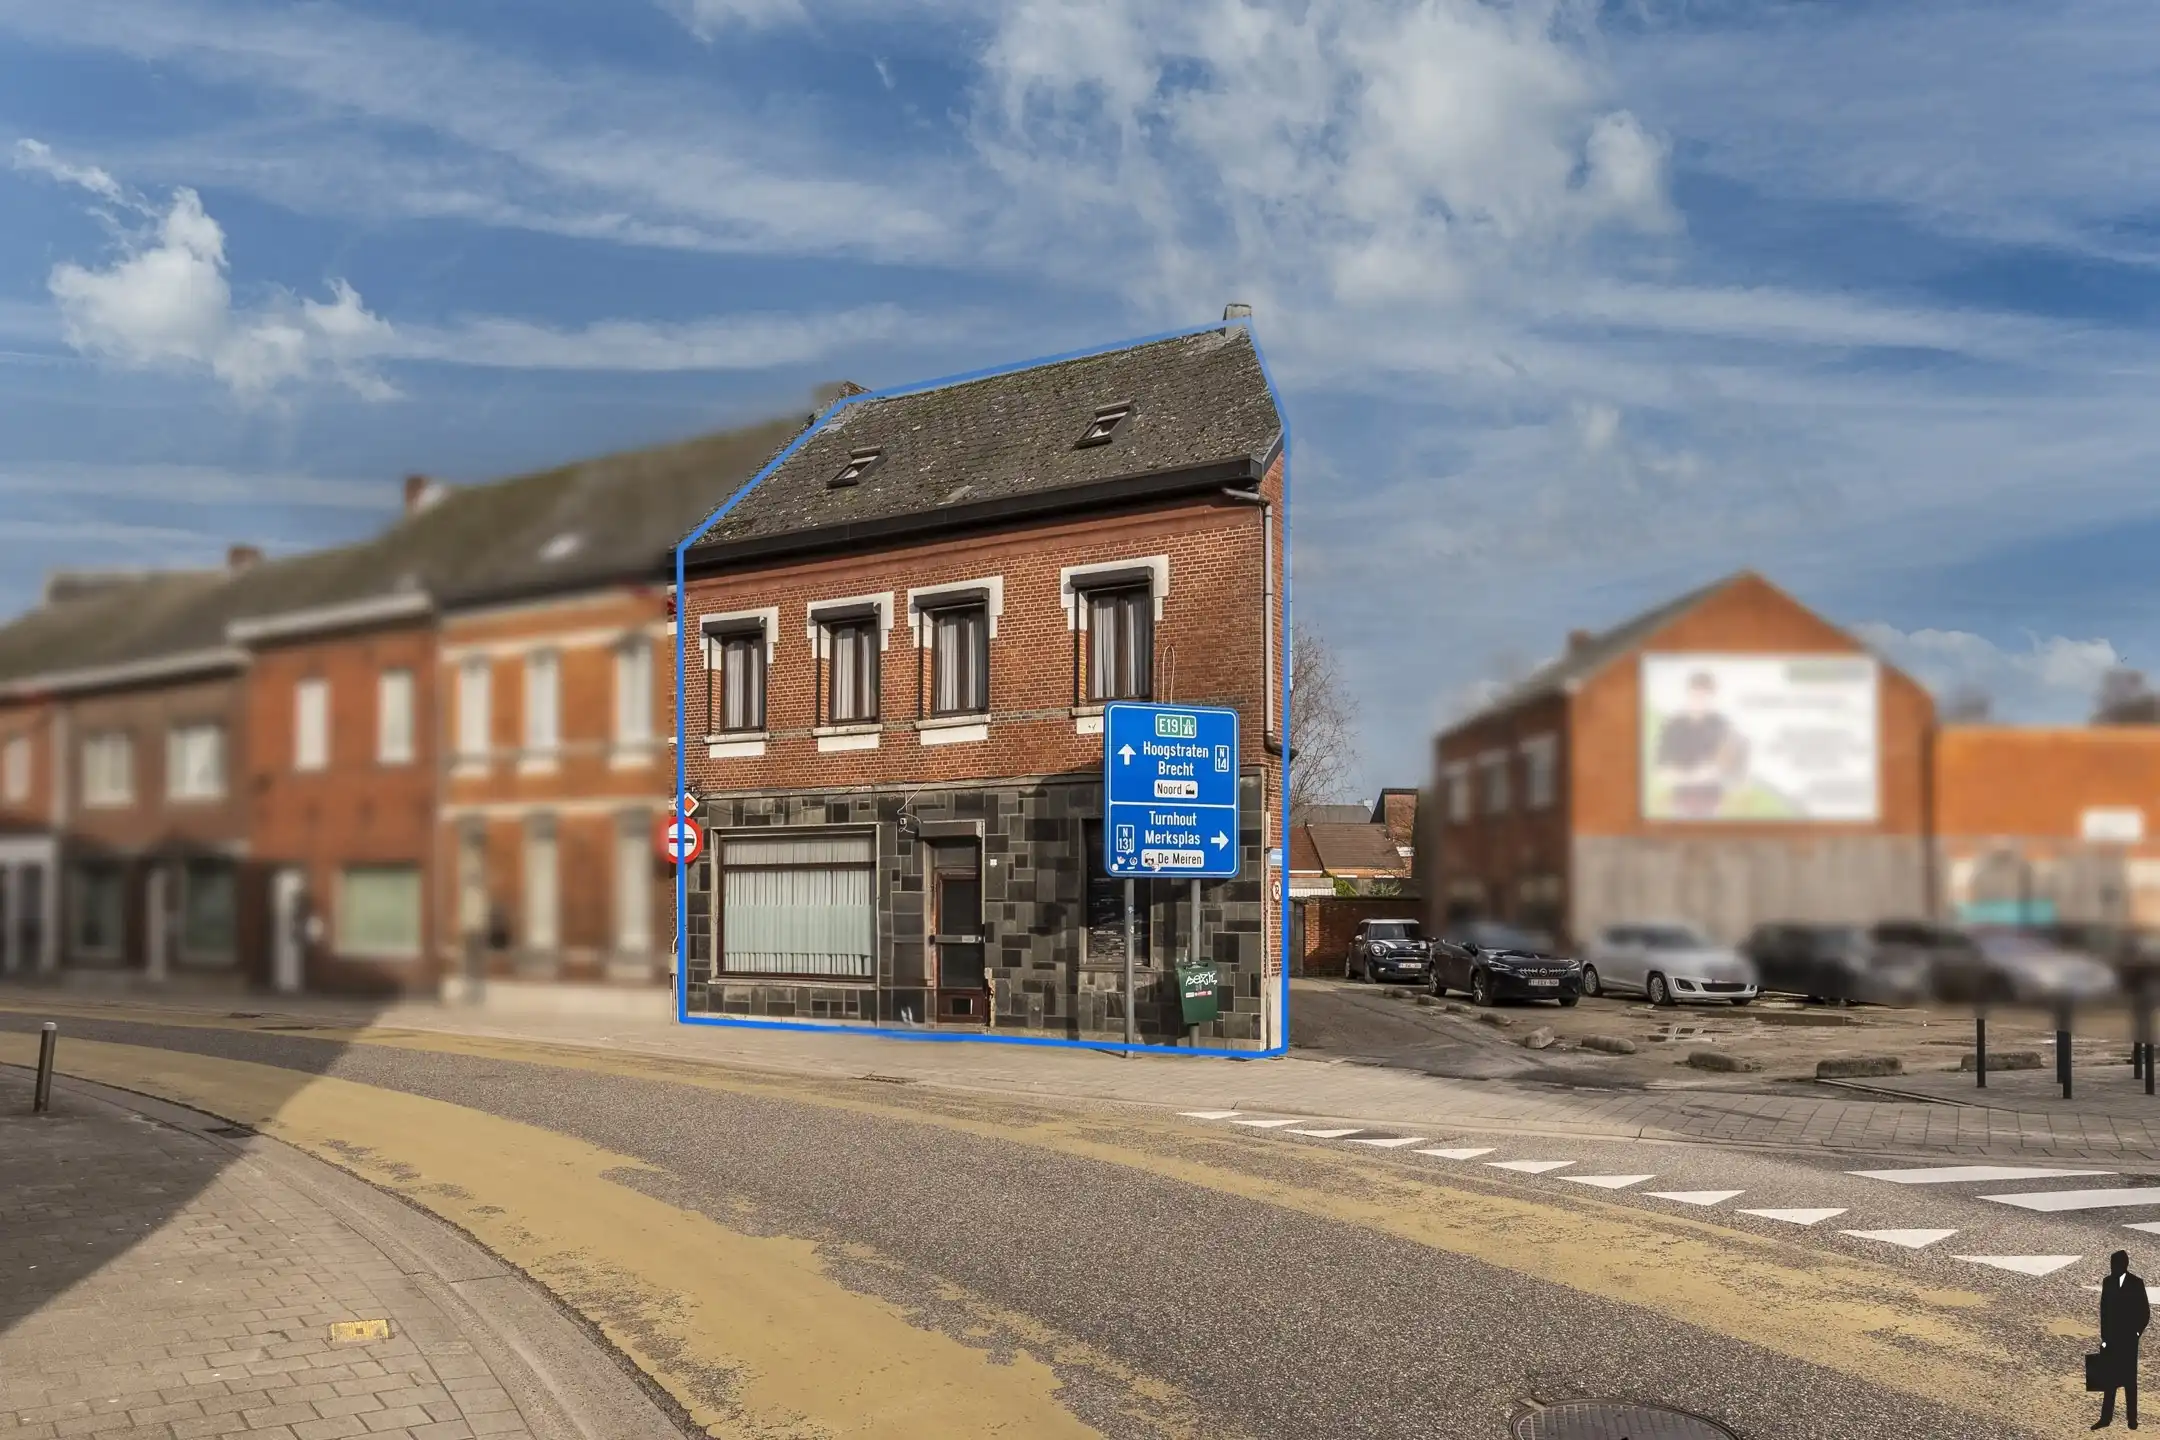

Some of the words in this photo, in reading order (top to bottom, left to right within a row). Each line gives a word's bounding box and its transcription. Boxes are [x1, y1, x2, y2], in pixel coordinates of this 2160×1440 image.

[1159, 719, 1179, 733] E19
[1143, 741, 1209, 759] Hoogstraten
[1219, 748, 1225, 757] N
[1158, 761, 1194, 776] Brecht
[1217, 758, 1227, 770] 14
[1157, 783, 1182, 795] Noord
[1149, 811, 1197, 826] Turnhout
[1122, 828, 1129, 837] N
[1118, 838, 1132, 850] 131
[1145, 830, 1200, 848] Merksplas
[1158, 853, 1169, 864] De
[1172, 853, 1202, 865] Meiren
